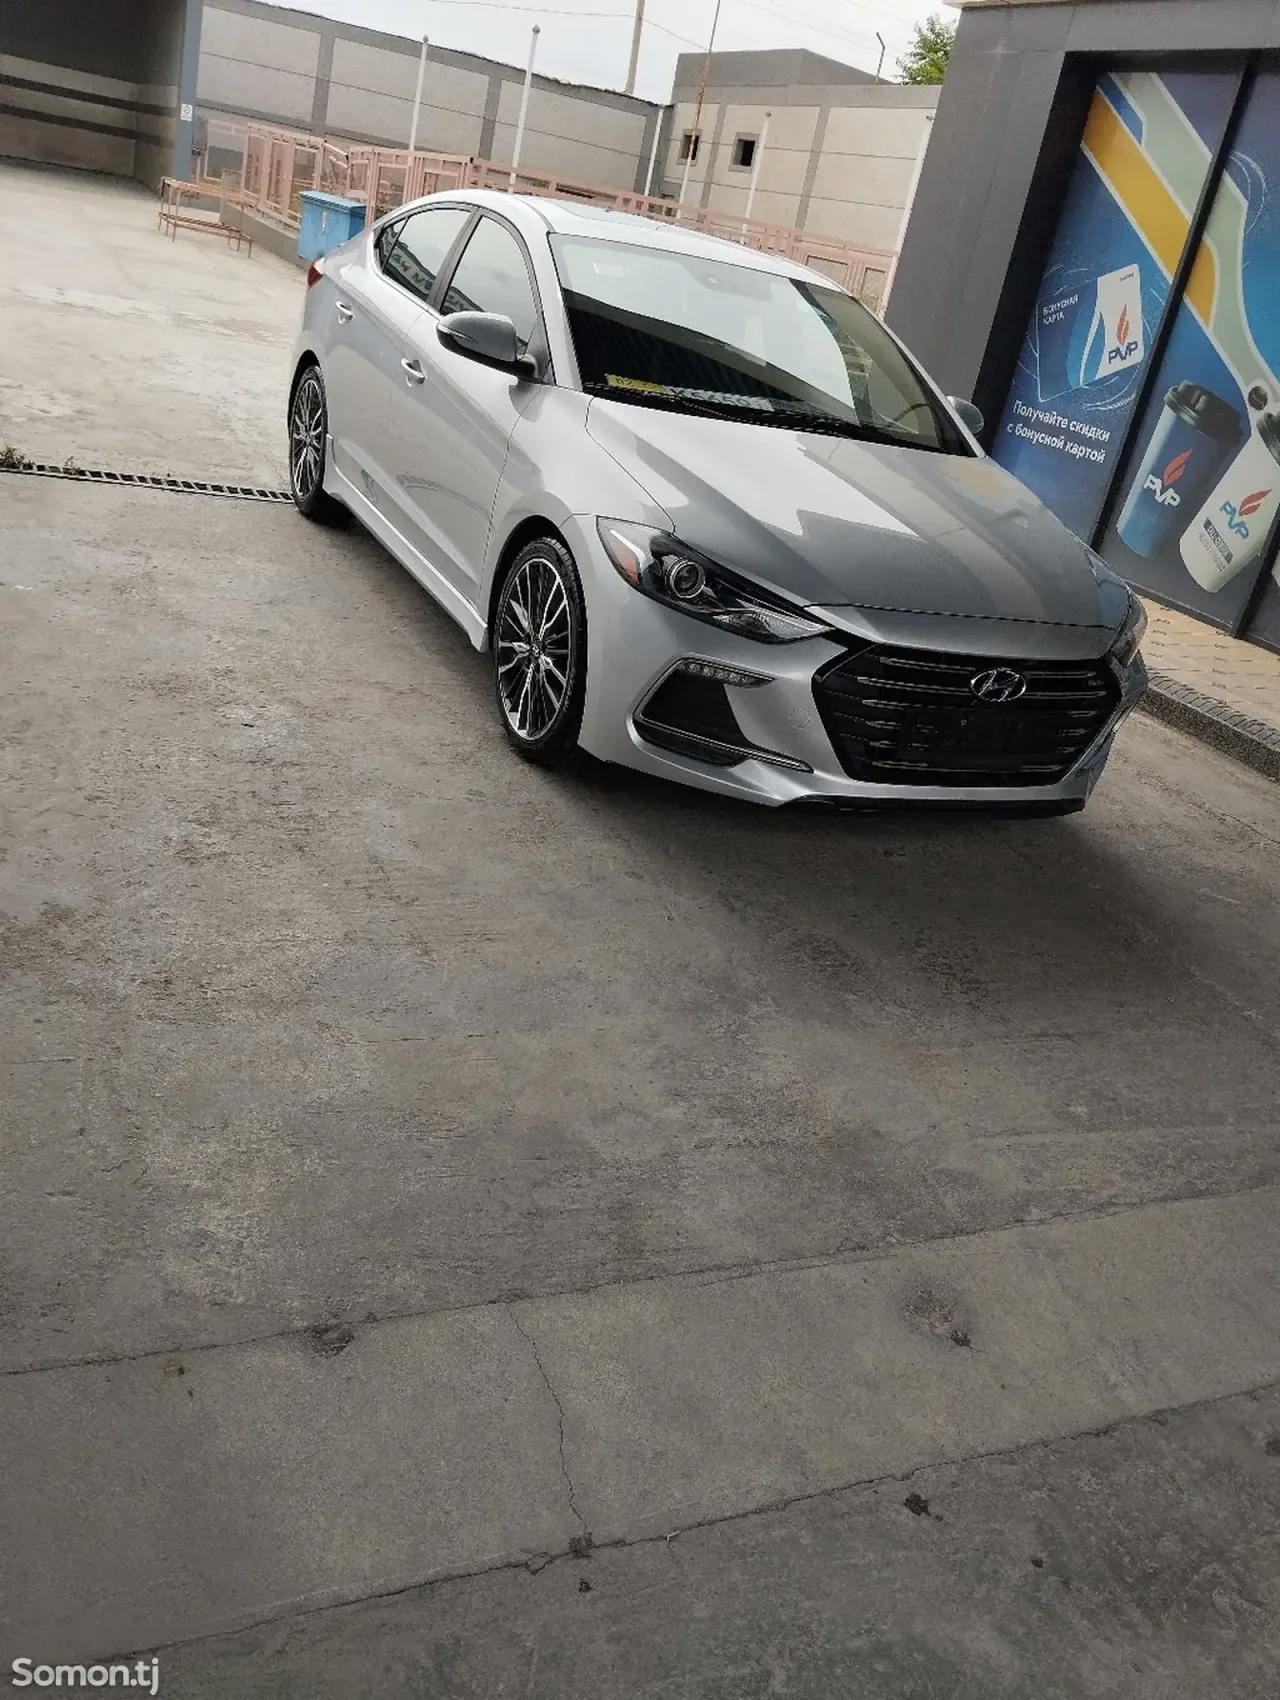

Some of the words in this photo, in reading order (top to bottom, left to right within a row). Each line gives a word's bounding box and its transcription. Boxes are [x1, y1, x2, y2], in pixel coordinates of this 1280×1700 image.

[1108, 341, 1139, 364] PVP
[1012, 399, 1068, 428] Получайте
[1069, 420, 1110, 442] скидки
[1006, 423, 1014, 433] с
[1015, 423, 1065, 445] бонусной
[1065, 441, 1106, 463] картой
[1143, 473, 1181, 507] PVP
[1220, 500, 1249, 539] PVP
